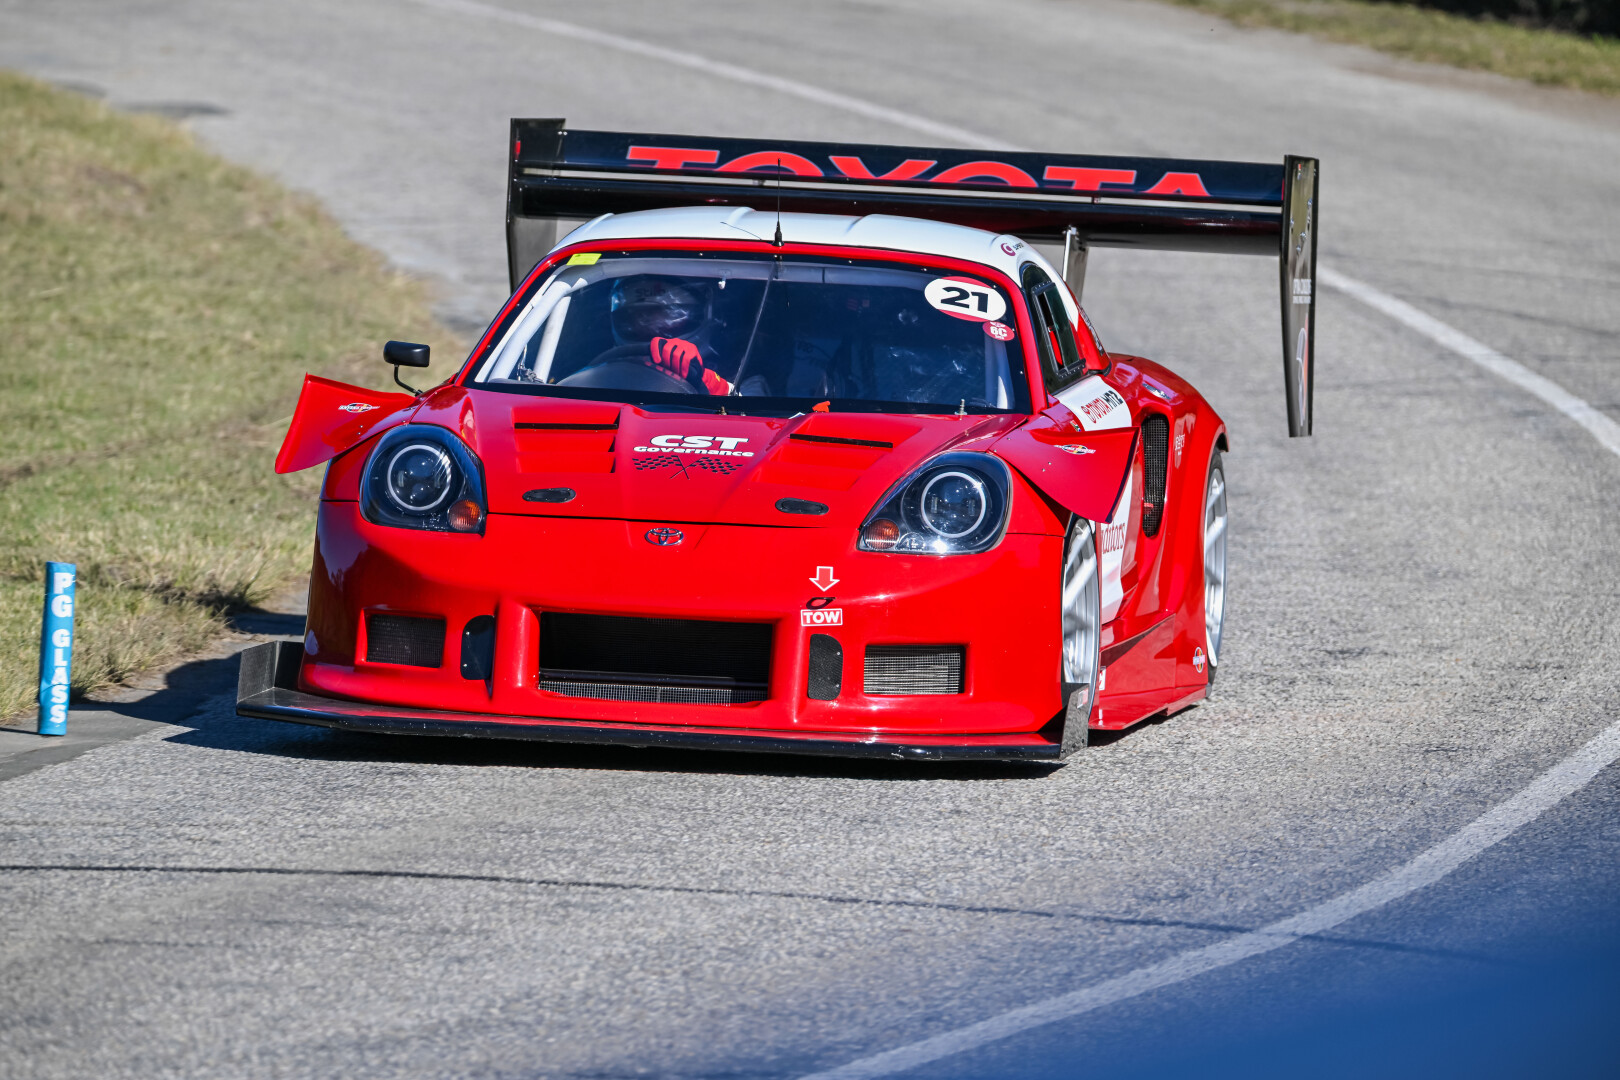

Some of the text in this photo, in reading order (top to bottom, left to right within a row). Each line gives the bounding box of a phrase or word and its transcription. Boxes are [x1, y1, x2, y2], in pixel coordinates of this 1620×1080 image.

[940, 286, 989, 314] 21
[650, 434, 749, 450] CST
[633, 446, 755, 457] Governance
[803, 611, 840, 624] TOW
[50, 572, 74, 724] PG GLASS
